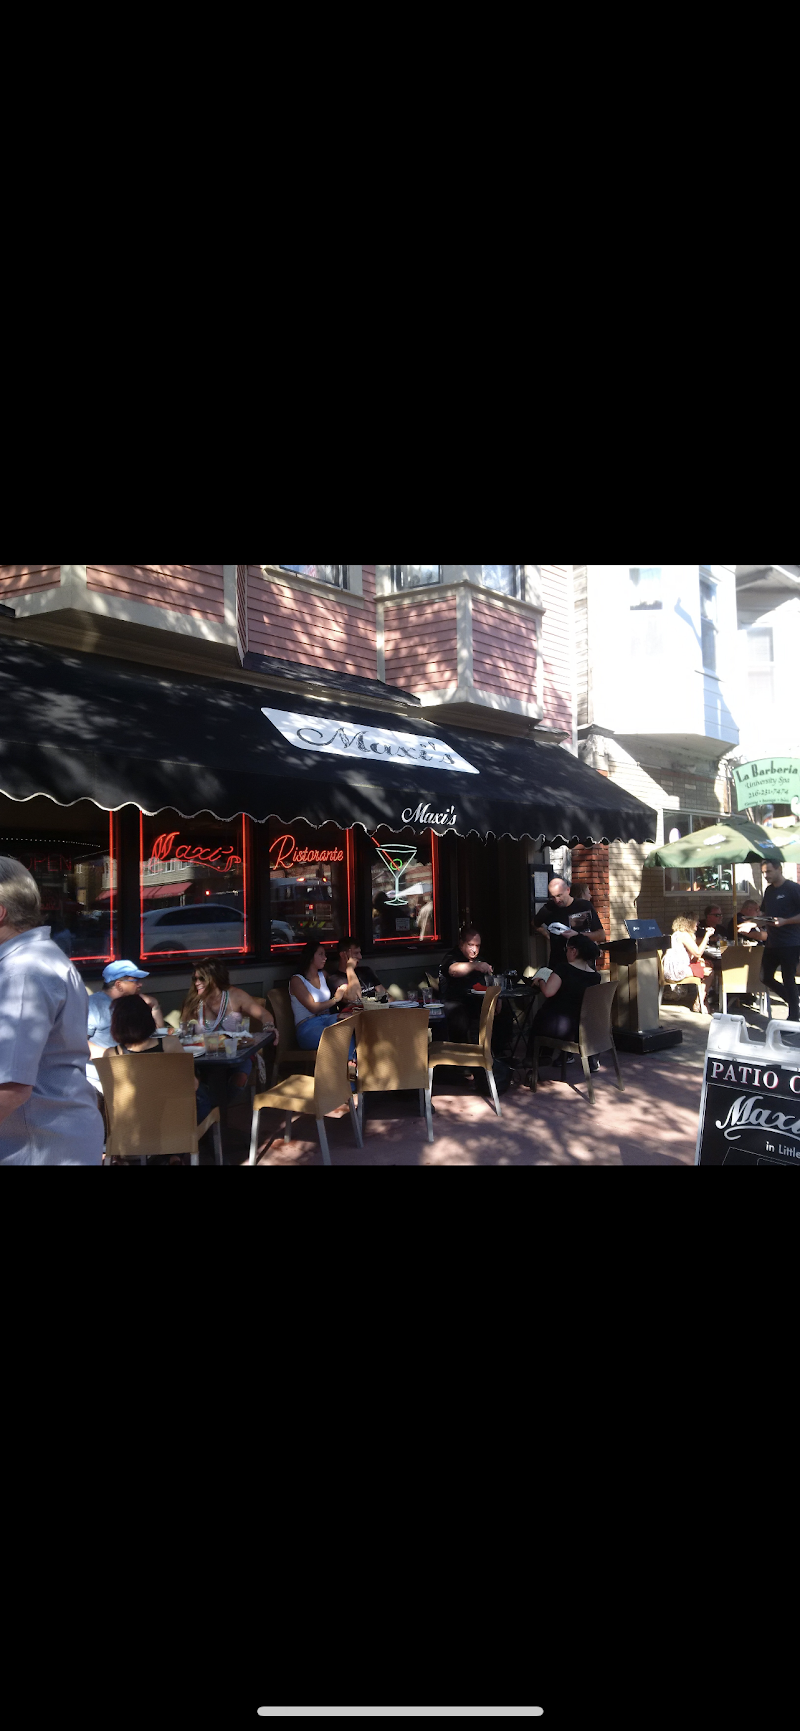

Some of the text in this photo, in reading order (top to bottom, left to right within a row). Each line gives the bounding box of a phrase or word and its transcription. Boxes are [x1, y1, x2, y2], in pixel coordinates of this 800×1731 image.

[296, 727, 455, 765] Maxi's
[736, 760, 798, 783] La Barberia
[745, 776, 790, 789] University Spa
[401, 802, 457, 826] Maxi's
[147, 832, 242, 873] Maxi's
[269, 834, 344, 870] Ristorante
[710, 1061, 779, 1089] PATIO
[766, 1141, 775, 1153] in
